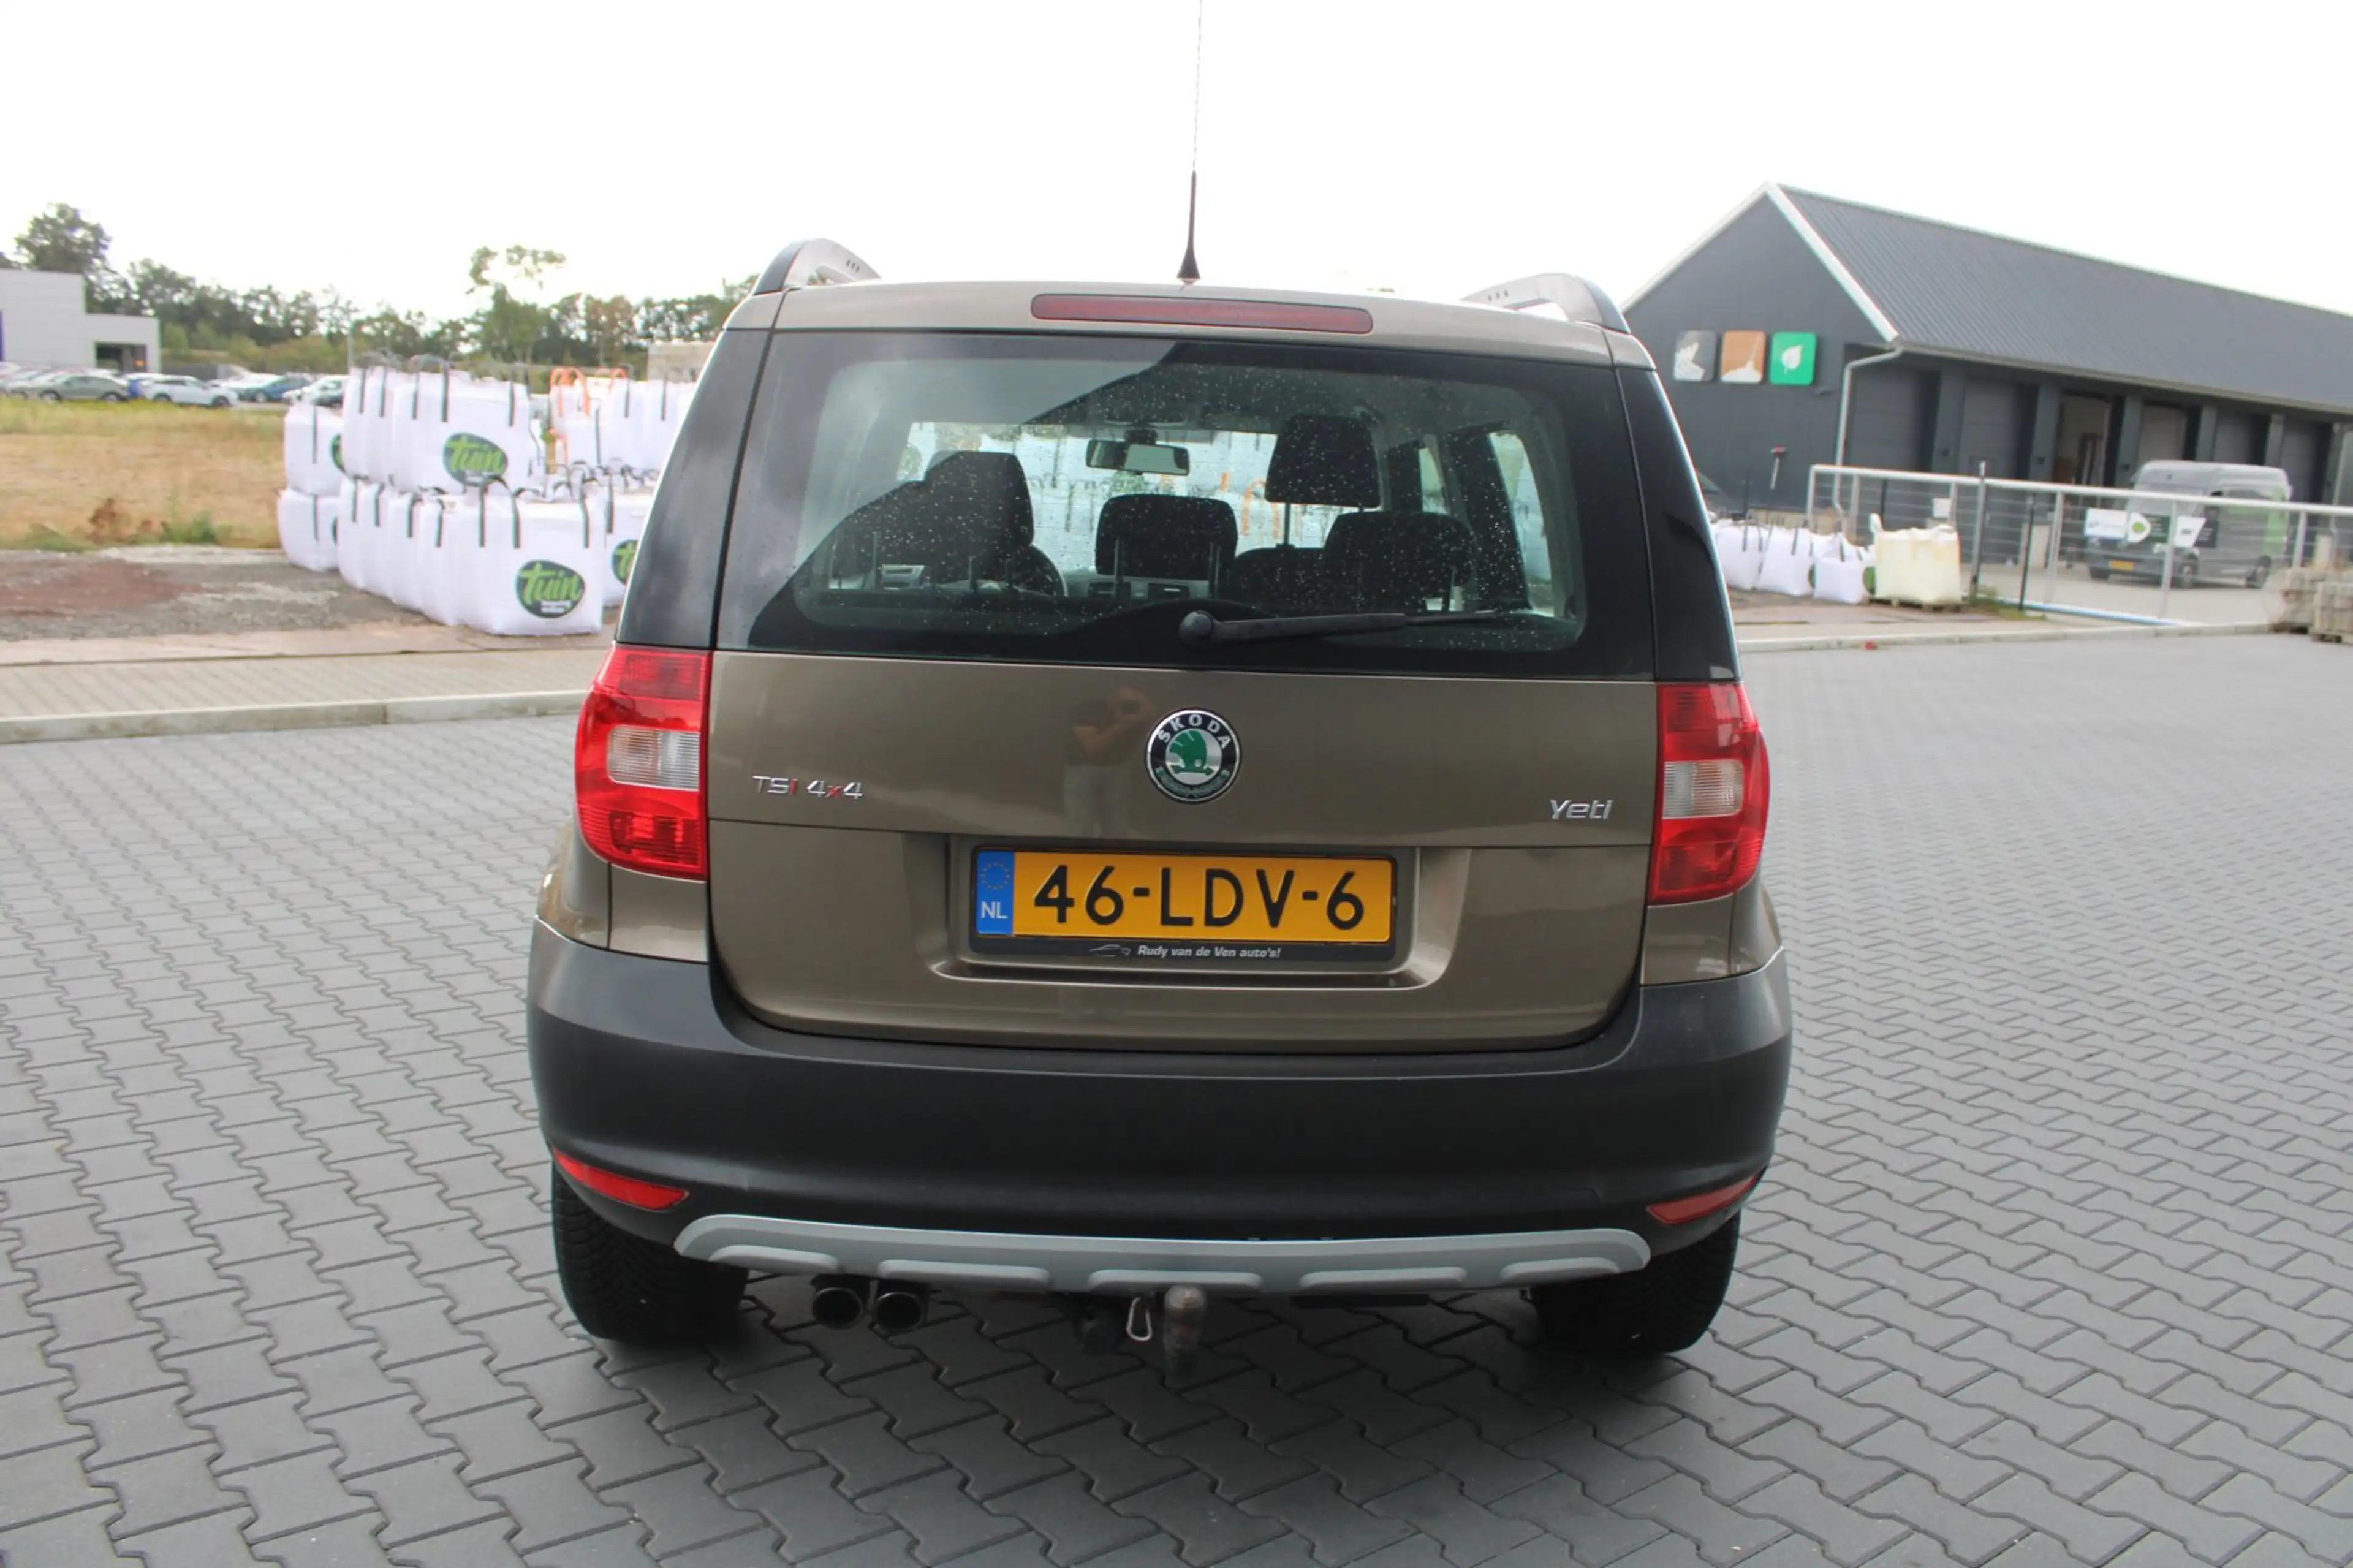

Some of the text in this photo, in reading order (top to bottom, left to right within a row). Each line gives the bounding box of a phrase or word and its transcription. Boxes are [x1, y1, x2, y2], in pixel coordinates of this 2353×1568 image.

[806, 779, 863, 800] 4x4
[1550, 799, 1613, 820] Yeti
[1033, 864, 1365, 931] 46-LDV-6
[981, 901, 1008, 919] NL
[1137, 944, 1282, 958] Rudy van de Ven auto's!
